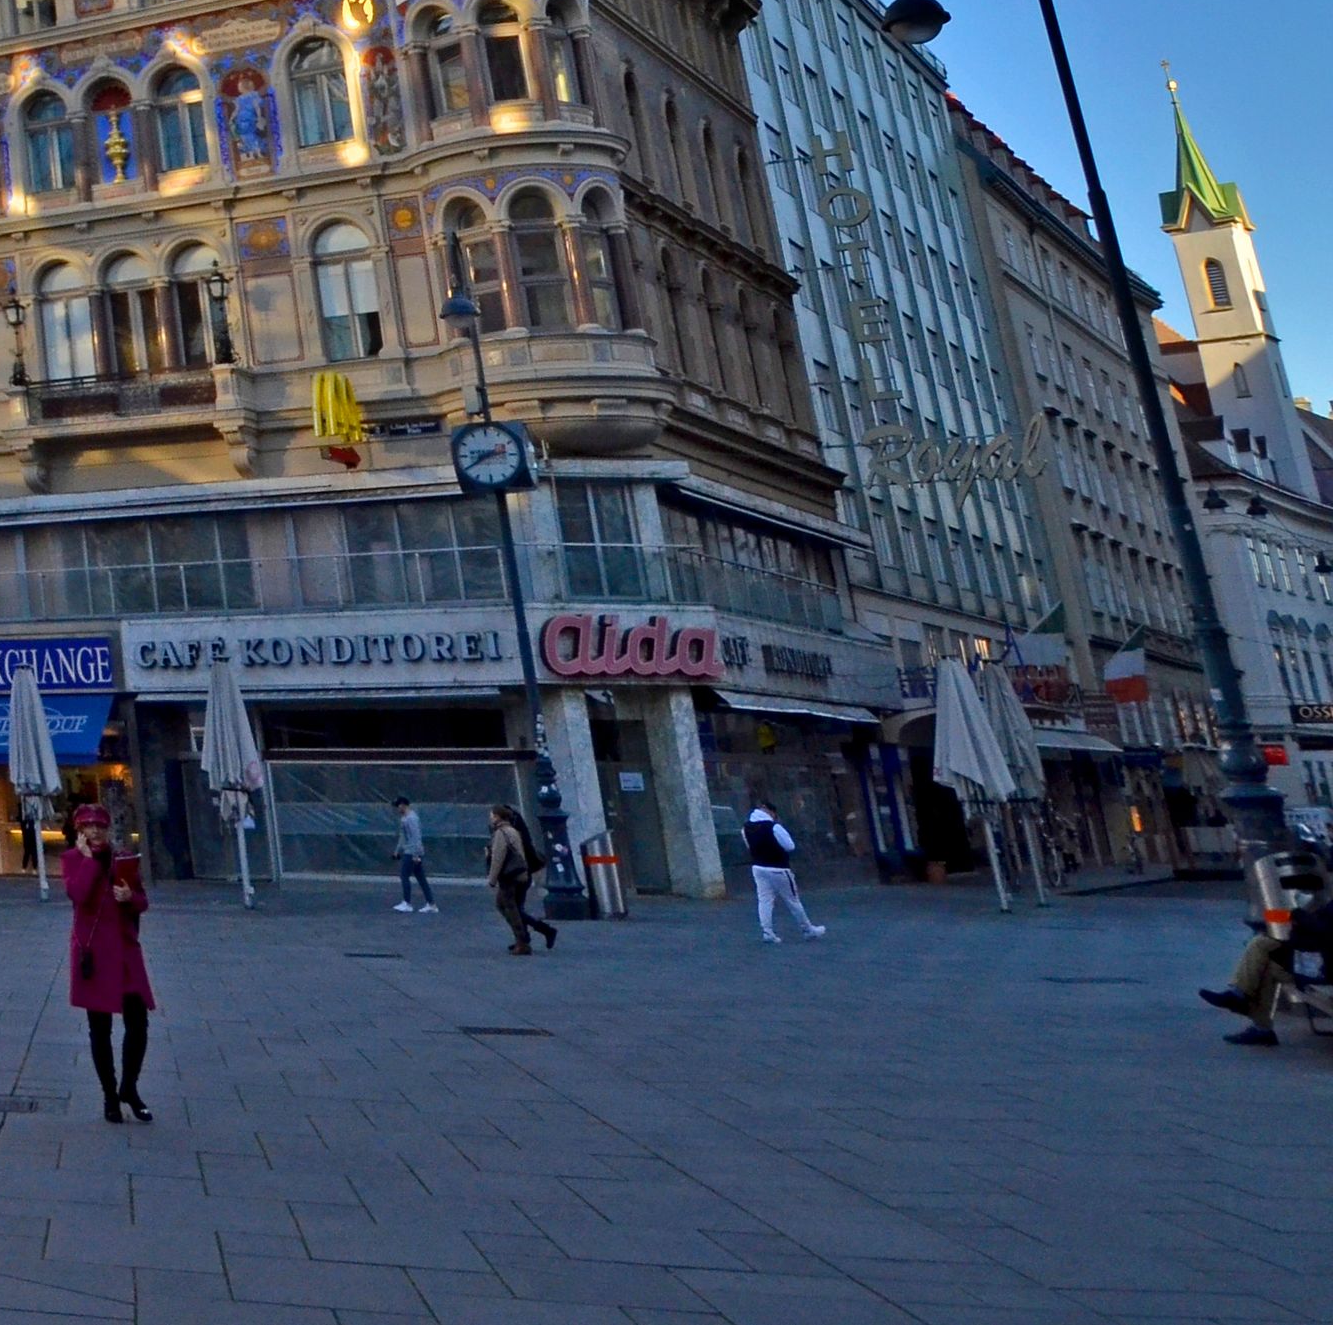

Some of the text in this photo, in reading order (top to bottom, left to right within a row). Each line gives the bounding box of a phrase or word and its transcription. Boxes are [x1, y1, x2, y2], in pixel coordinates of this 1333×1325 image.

[811, 130, 903, 402] HOTEL
[862, 411, 1048, 510] Royal
[238, 630, 502, 668] KONDITOREI
[50, 716, 87, 732] OUP
